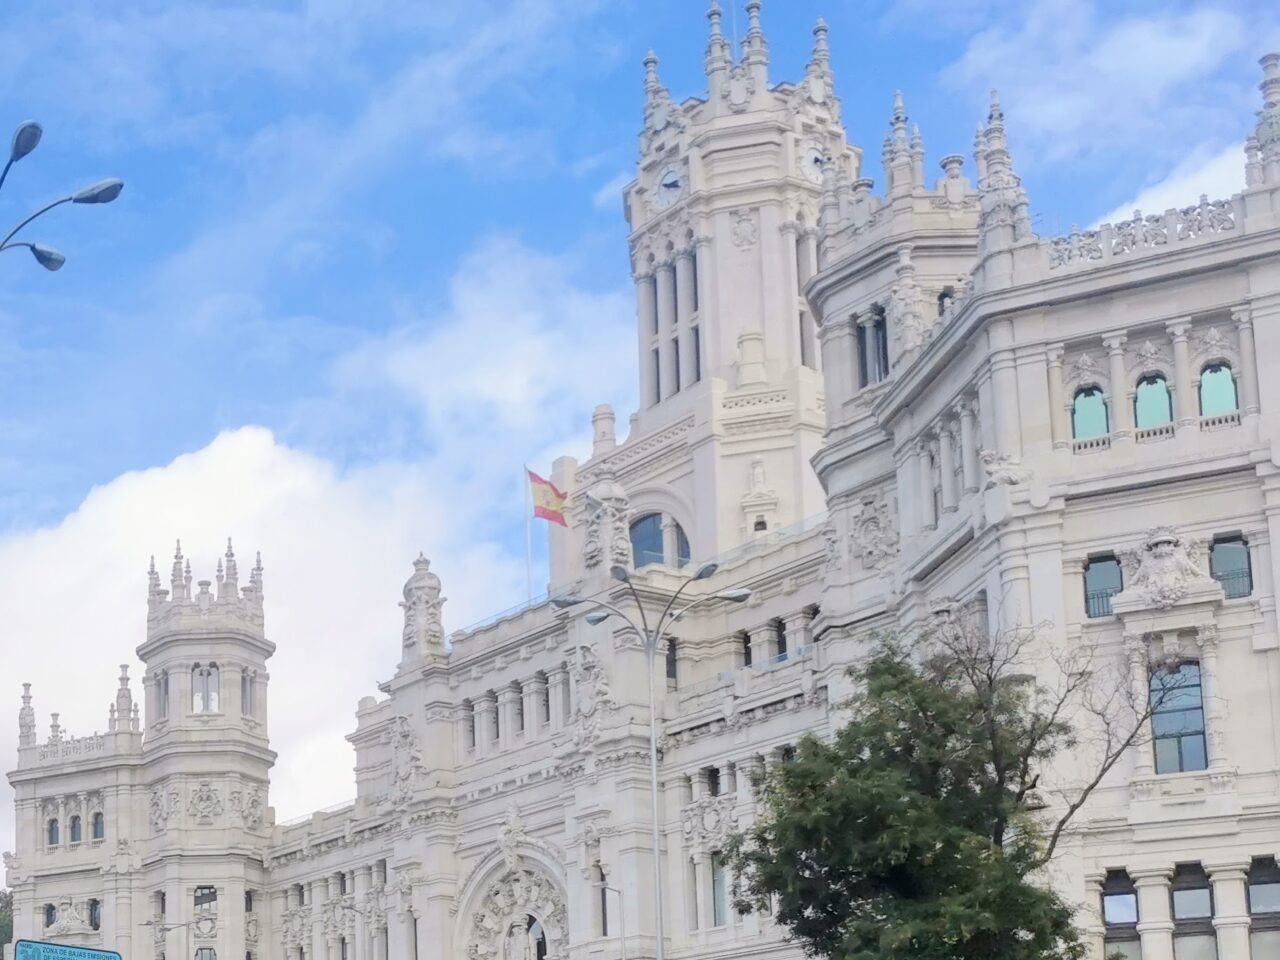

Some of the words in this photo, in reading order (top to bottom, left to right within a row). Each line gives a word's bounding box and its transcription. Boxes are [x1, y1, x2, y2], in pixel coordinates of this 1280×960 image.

[42, 947, 58, 955] ZONA
[59, 948, 67, 956] DE
[68, 950, 87, 958] BAJAS
